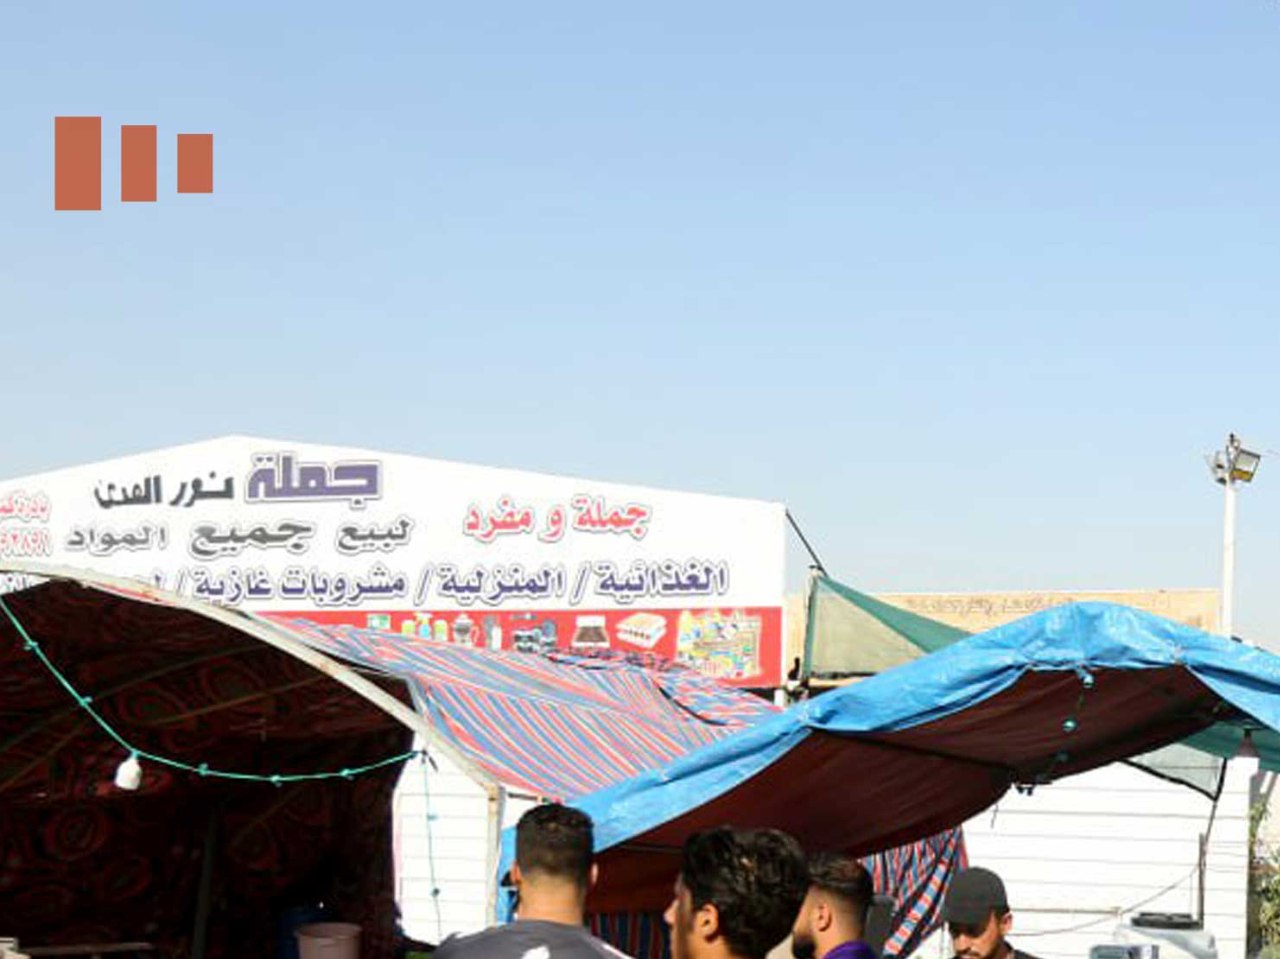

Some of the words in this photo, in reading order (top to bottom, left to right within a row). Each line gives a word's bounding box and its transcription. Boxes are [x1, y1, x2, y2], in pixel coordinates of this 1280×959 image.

[169, 470, 236, 508] نور
[248, 452, 382, 509] جملة
[336, 517, 413, 553] لبيع
[463, 497, 535, 541] مفرد
[538, 505, 565, 540] و
[574, 494, 651, 539] جملة
[66, 524, 168, 550] المواد
[190, 518, 314, 558] جميع
[195, 569, 273, 605] غازية
[280, 565, 407, 605] مشروبات
[439, 563, 565, 603] المنزلية
[597, 561, 729, 602] الغذائية
